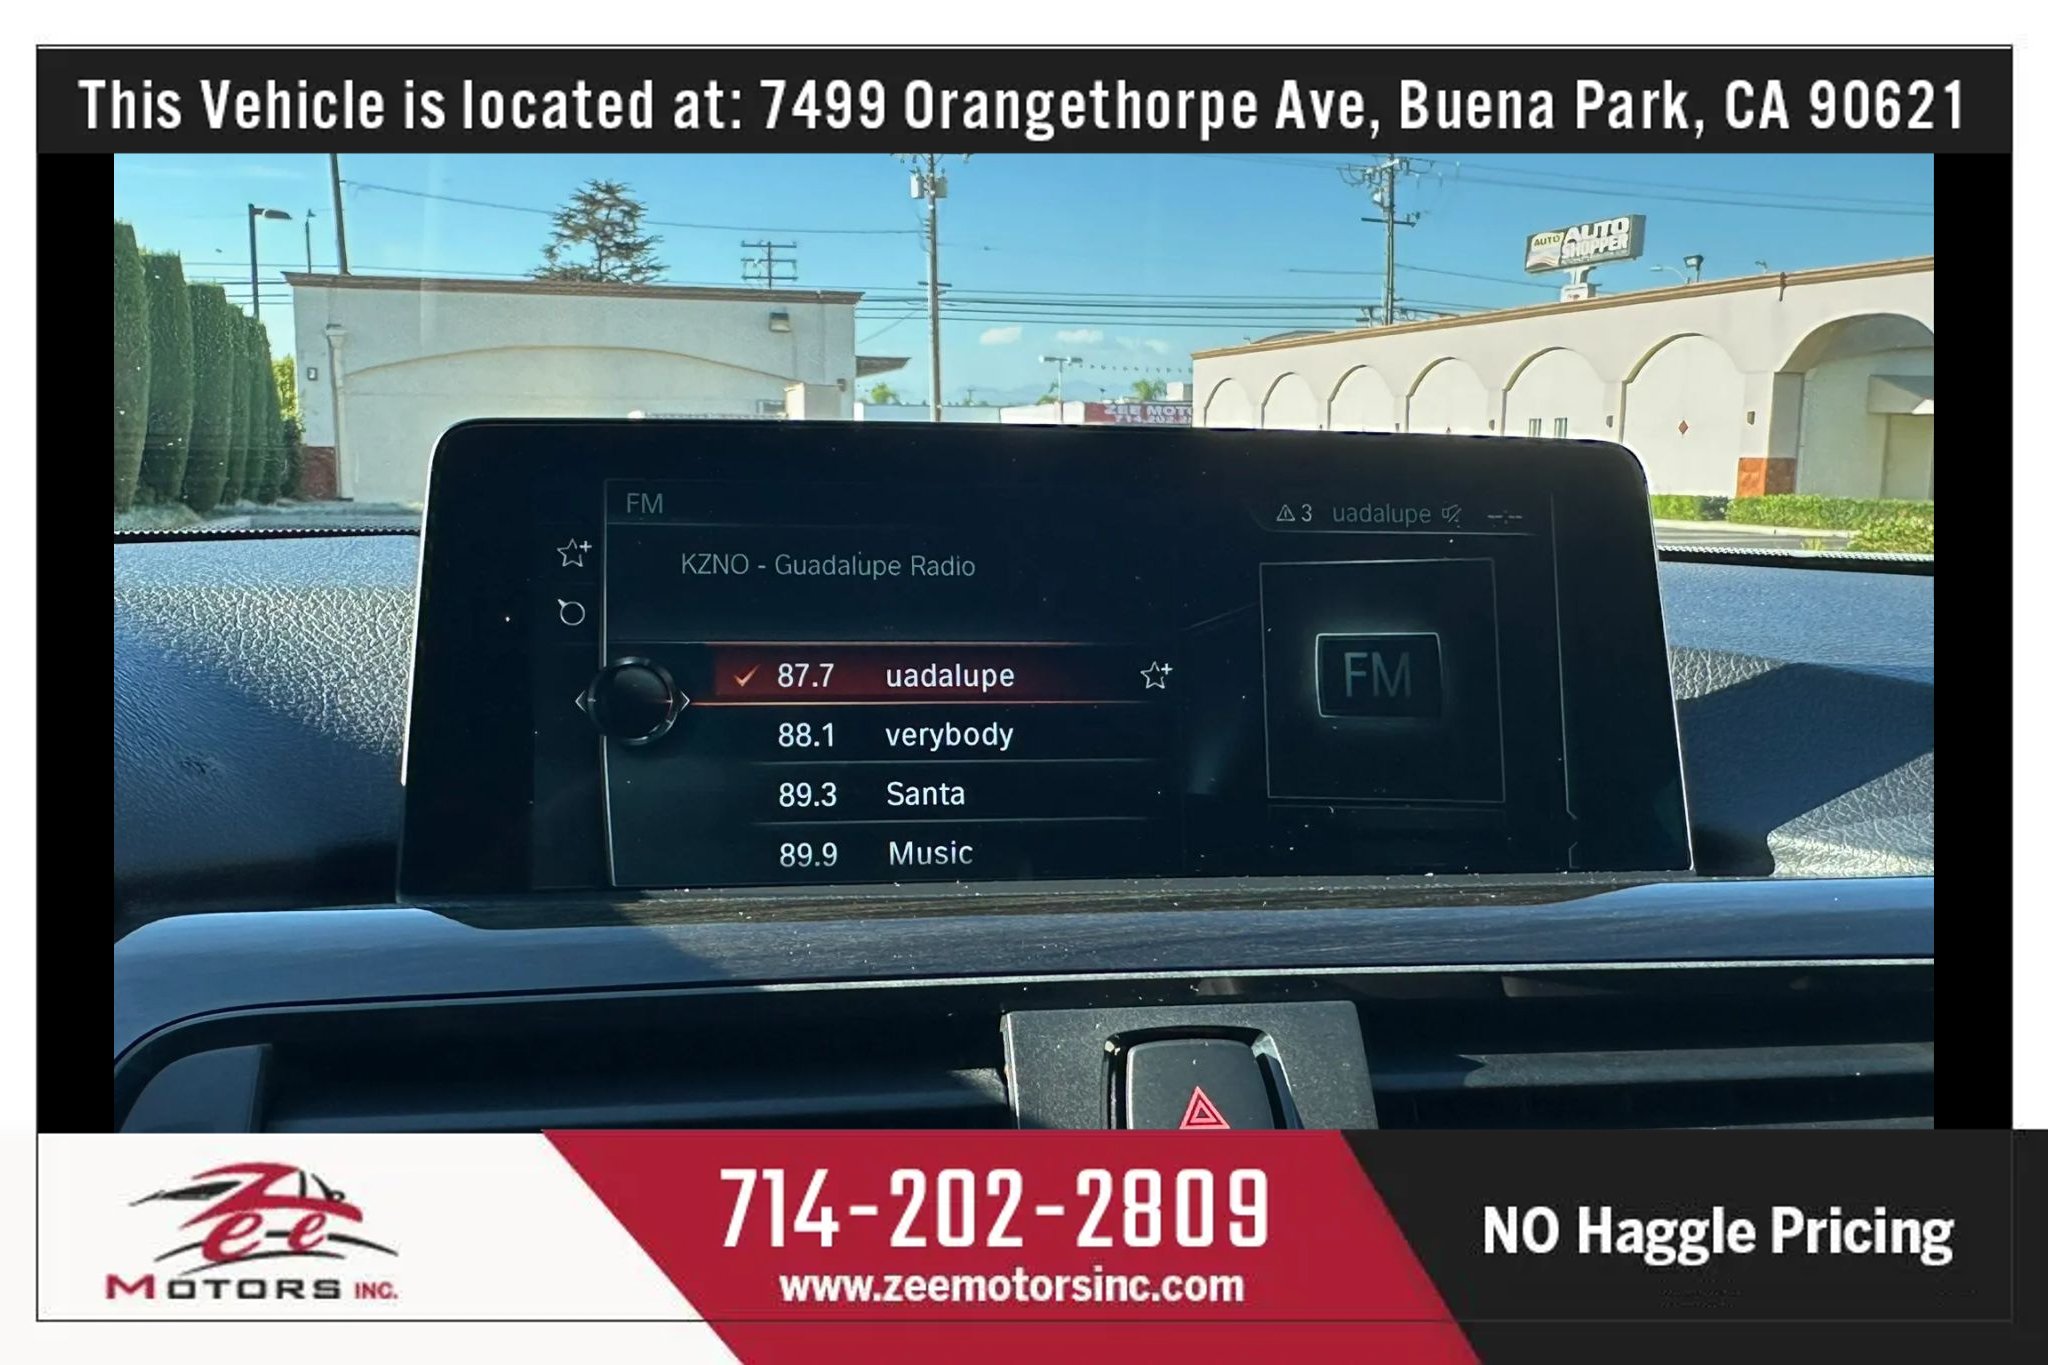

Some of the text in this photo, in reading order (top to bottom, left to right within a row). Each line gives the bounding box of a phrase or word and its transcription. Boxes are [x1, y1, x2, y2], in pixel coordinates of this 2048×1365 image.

[1533, 234, 1561, 247] AUTO
[1564, 217, 1630, 241] AUTO
[1561, 233, 1629, 259] SHOPPER
[626, 493, 664, 514] FM
[1301, 503, 1432, 528] 3 uadalupe
[682, 553, 750, 575] KZNO
[775, 552, 902, 580] Guadalupe
[911, 554, 976, 578] Radio
[777, 663, 1015, 693] 87.7 uadalupe
[1343, 651, 1412, 699] FM
[778, 721, 1014, 752] 88.1 verybody
[779, 781, 966, 808] 89.3 Santa
[779, 840, 974, 868] 89.9 Music
